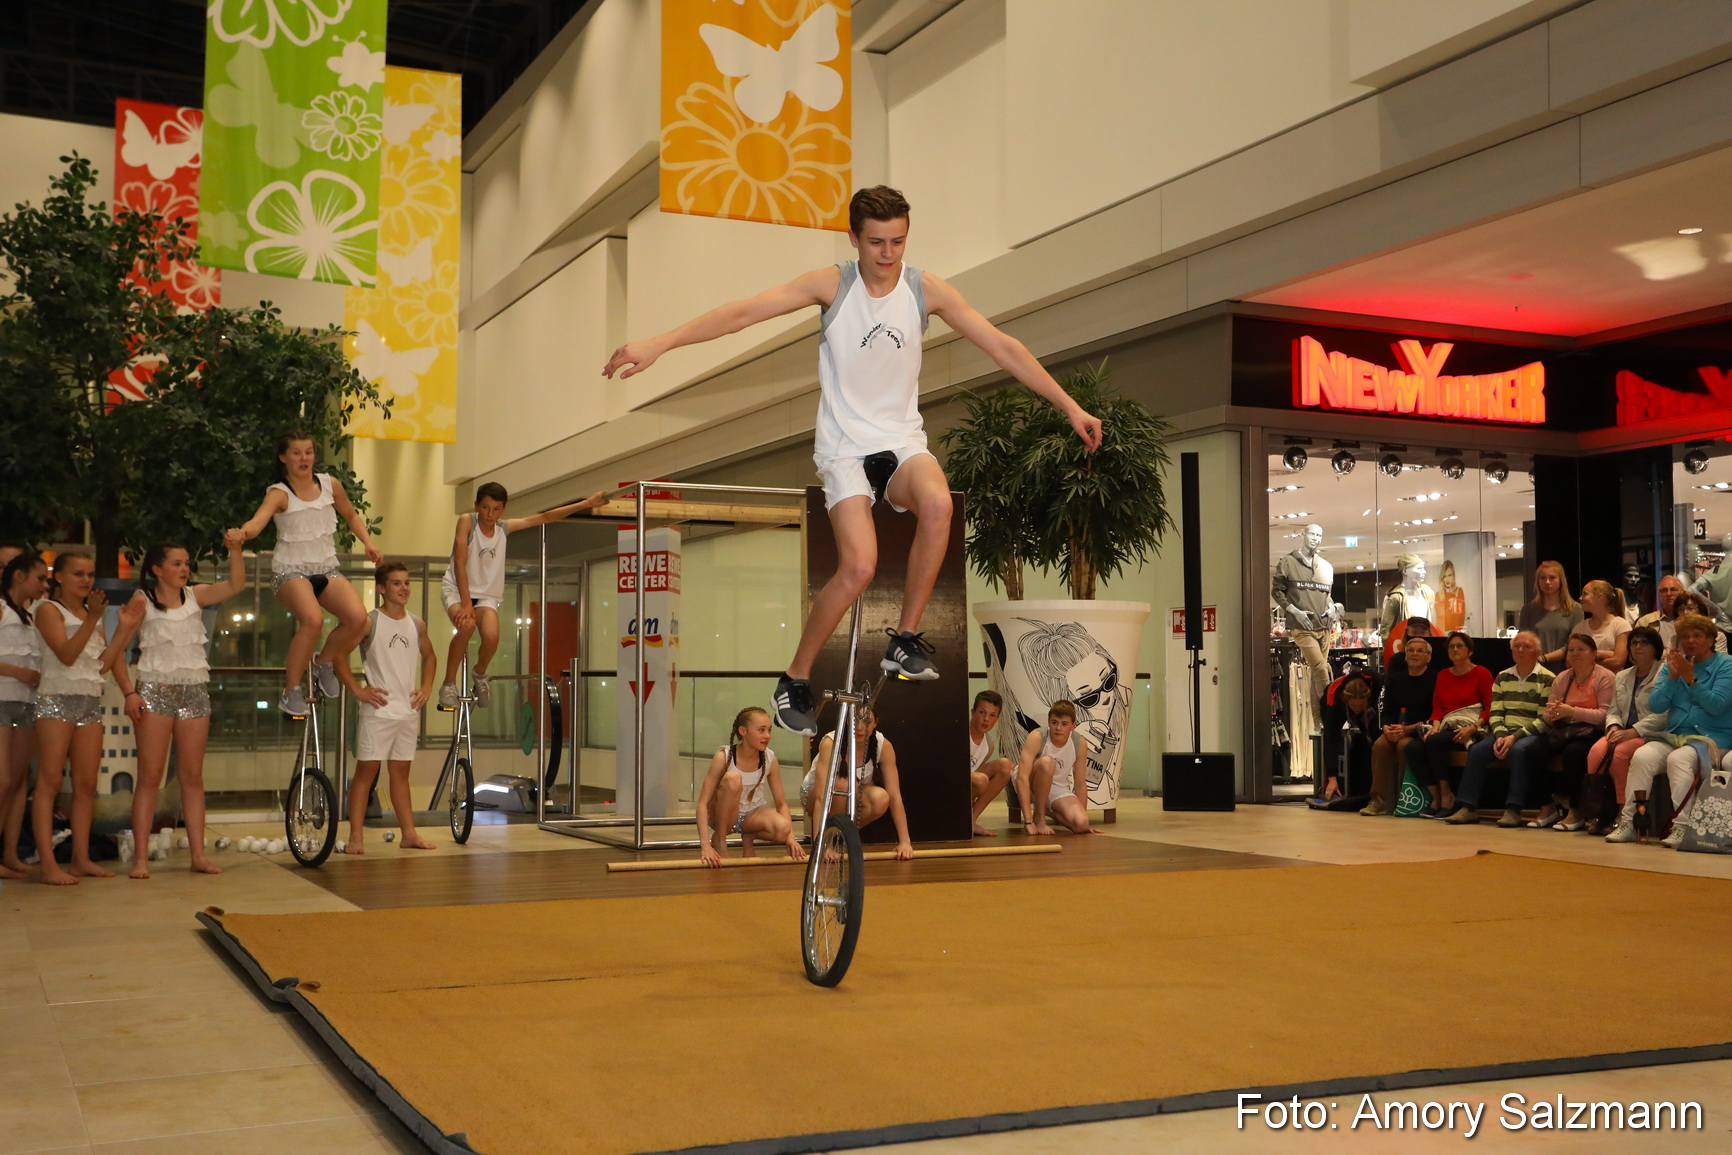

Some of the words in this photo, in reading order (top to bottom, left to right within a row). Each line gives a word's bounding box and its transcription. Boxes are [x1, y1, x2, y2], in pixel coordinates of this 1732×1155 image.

[860, 323, 882, 348] Wonder
[886, 330, 901, 349] Teens
[619, 575, 667, 589] CETER
